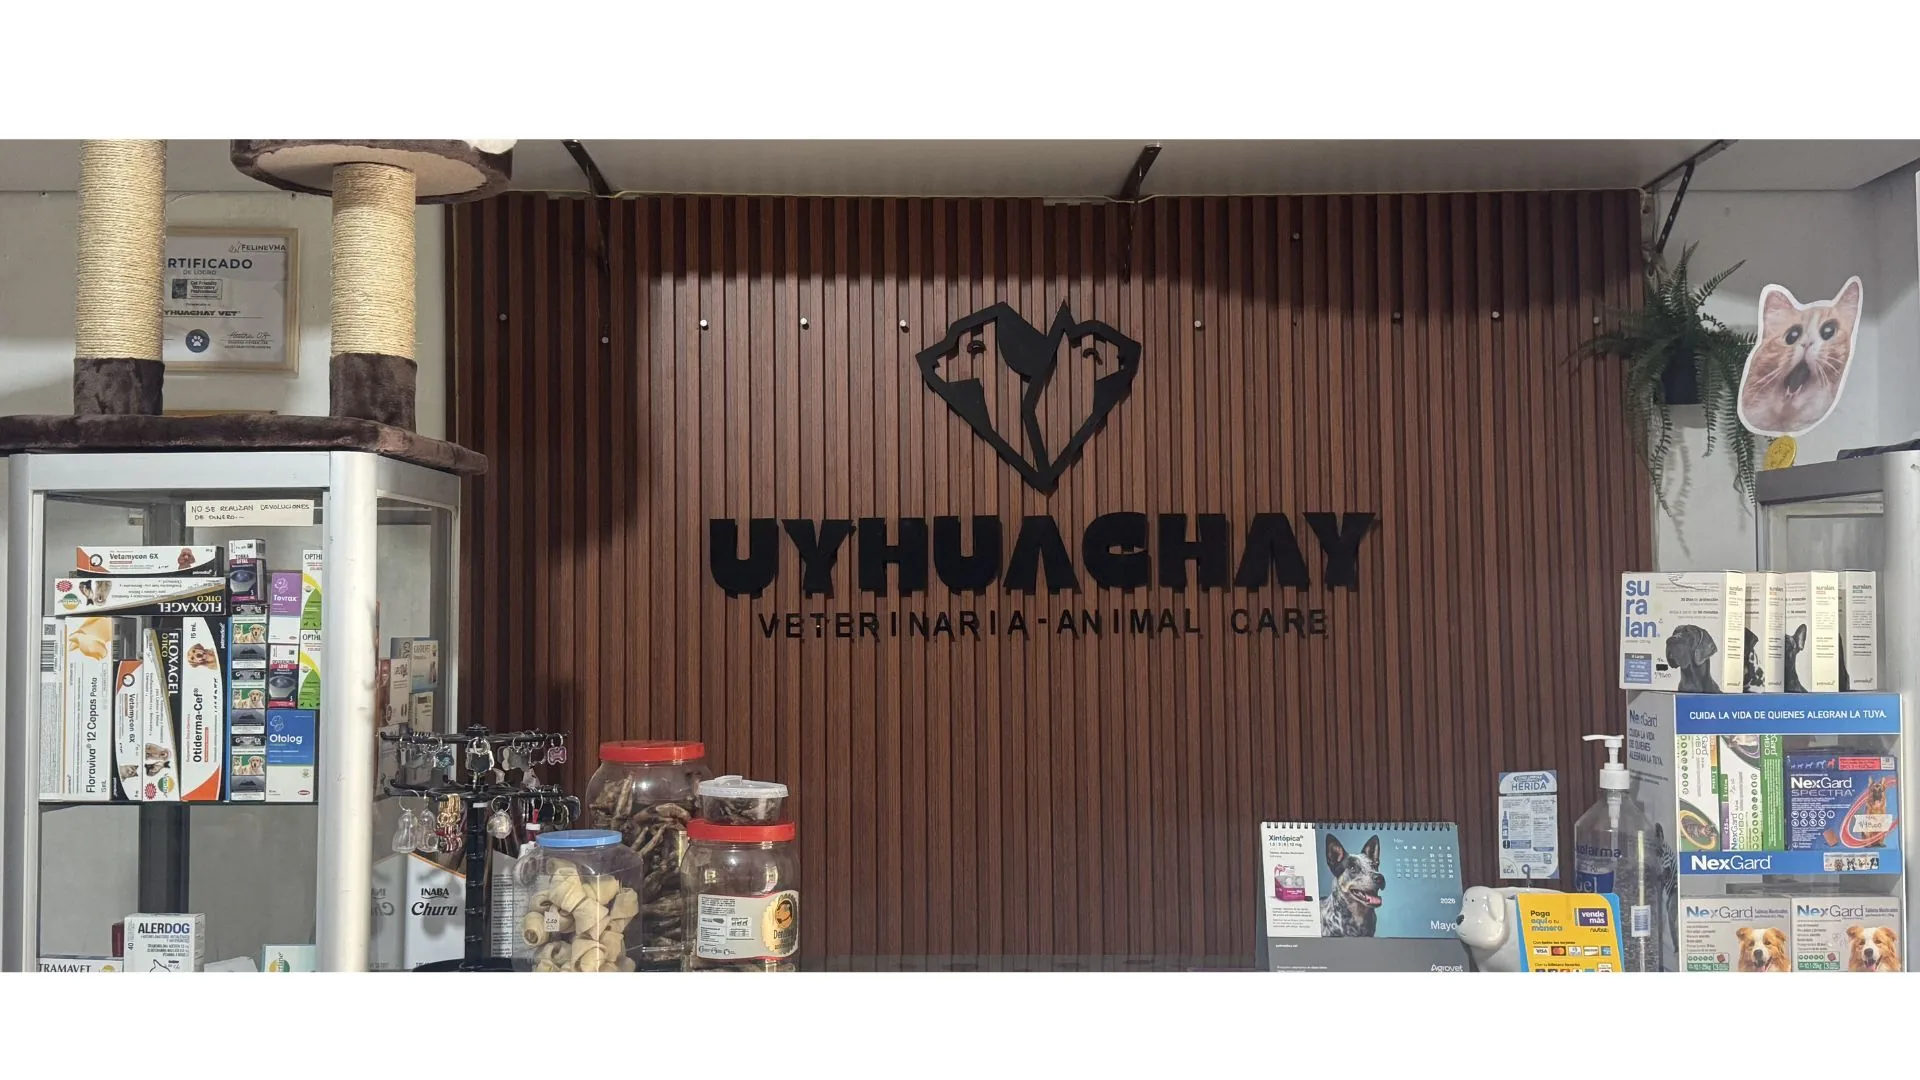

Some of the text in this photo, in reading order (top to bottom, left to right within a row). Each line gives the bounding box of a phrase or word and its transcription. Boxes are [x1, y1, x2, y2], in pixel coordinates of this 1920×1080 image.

[167, 258, 253, 269] RTIFICADO
[191, 505, 203, 513] NO
[205, 505, 216, 513] SE
[109, 553, 148, 561] Vetamycon
[1625, 580, 1650, 596] su
[158, 602, 222, 613] FLOXAGEL
[1625, 598, 1648, 615] ra
[1230, 608, 1328, 638] CARE
[1625, 616, 1657, 638] lan
[168, 632, 179, 696] FLOXAGEL
[128, 693, 136, 732] Vetamycon
[1689, 711, 1716, 720] CUIDA
[1718, 711, 1730, 720] LA
[1731, 711, 1752, 720] VIDA
[1754, 711, 1766, 720] DE
[1767, 711, 1805, 720] QUIENES
[1807, 710, 1848, 719] ALEGRAN
[1849, 710, 1861, 719] LA
[87, 732, 96, 742] 12
[269, 734, 303, 745] Otolog
[1511, 782, 1547, 791] HERIDA
[1790, 777, 1852, 789] NexGard
[1691, 855, 1772, 871] NexGard
[421, 887, 450, 896] INABA
[411, 901, 458, 916] Churu
[1530, 910, 1551, 918] Paga
[1581, 910, 1605, 918] vende
[1686, 906, 1753, 919] NexGard
[1797, 904, 1864, 918] NexGard
[137, 922, 190, 934] ALERDOG
[1430, 920, 1457, 932] Mayo
[127, 942, 134, 951] 40
